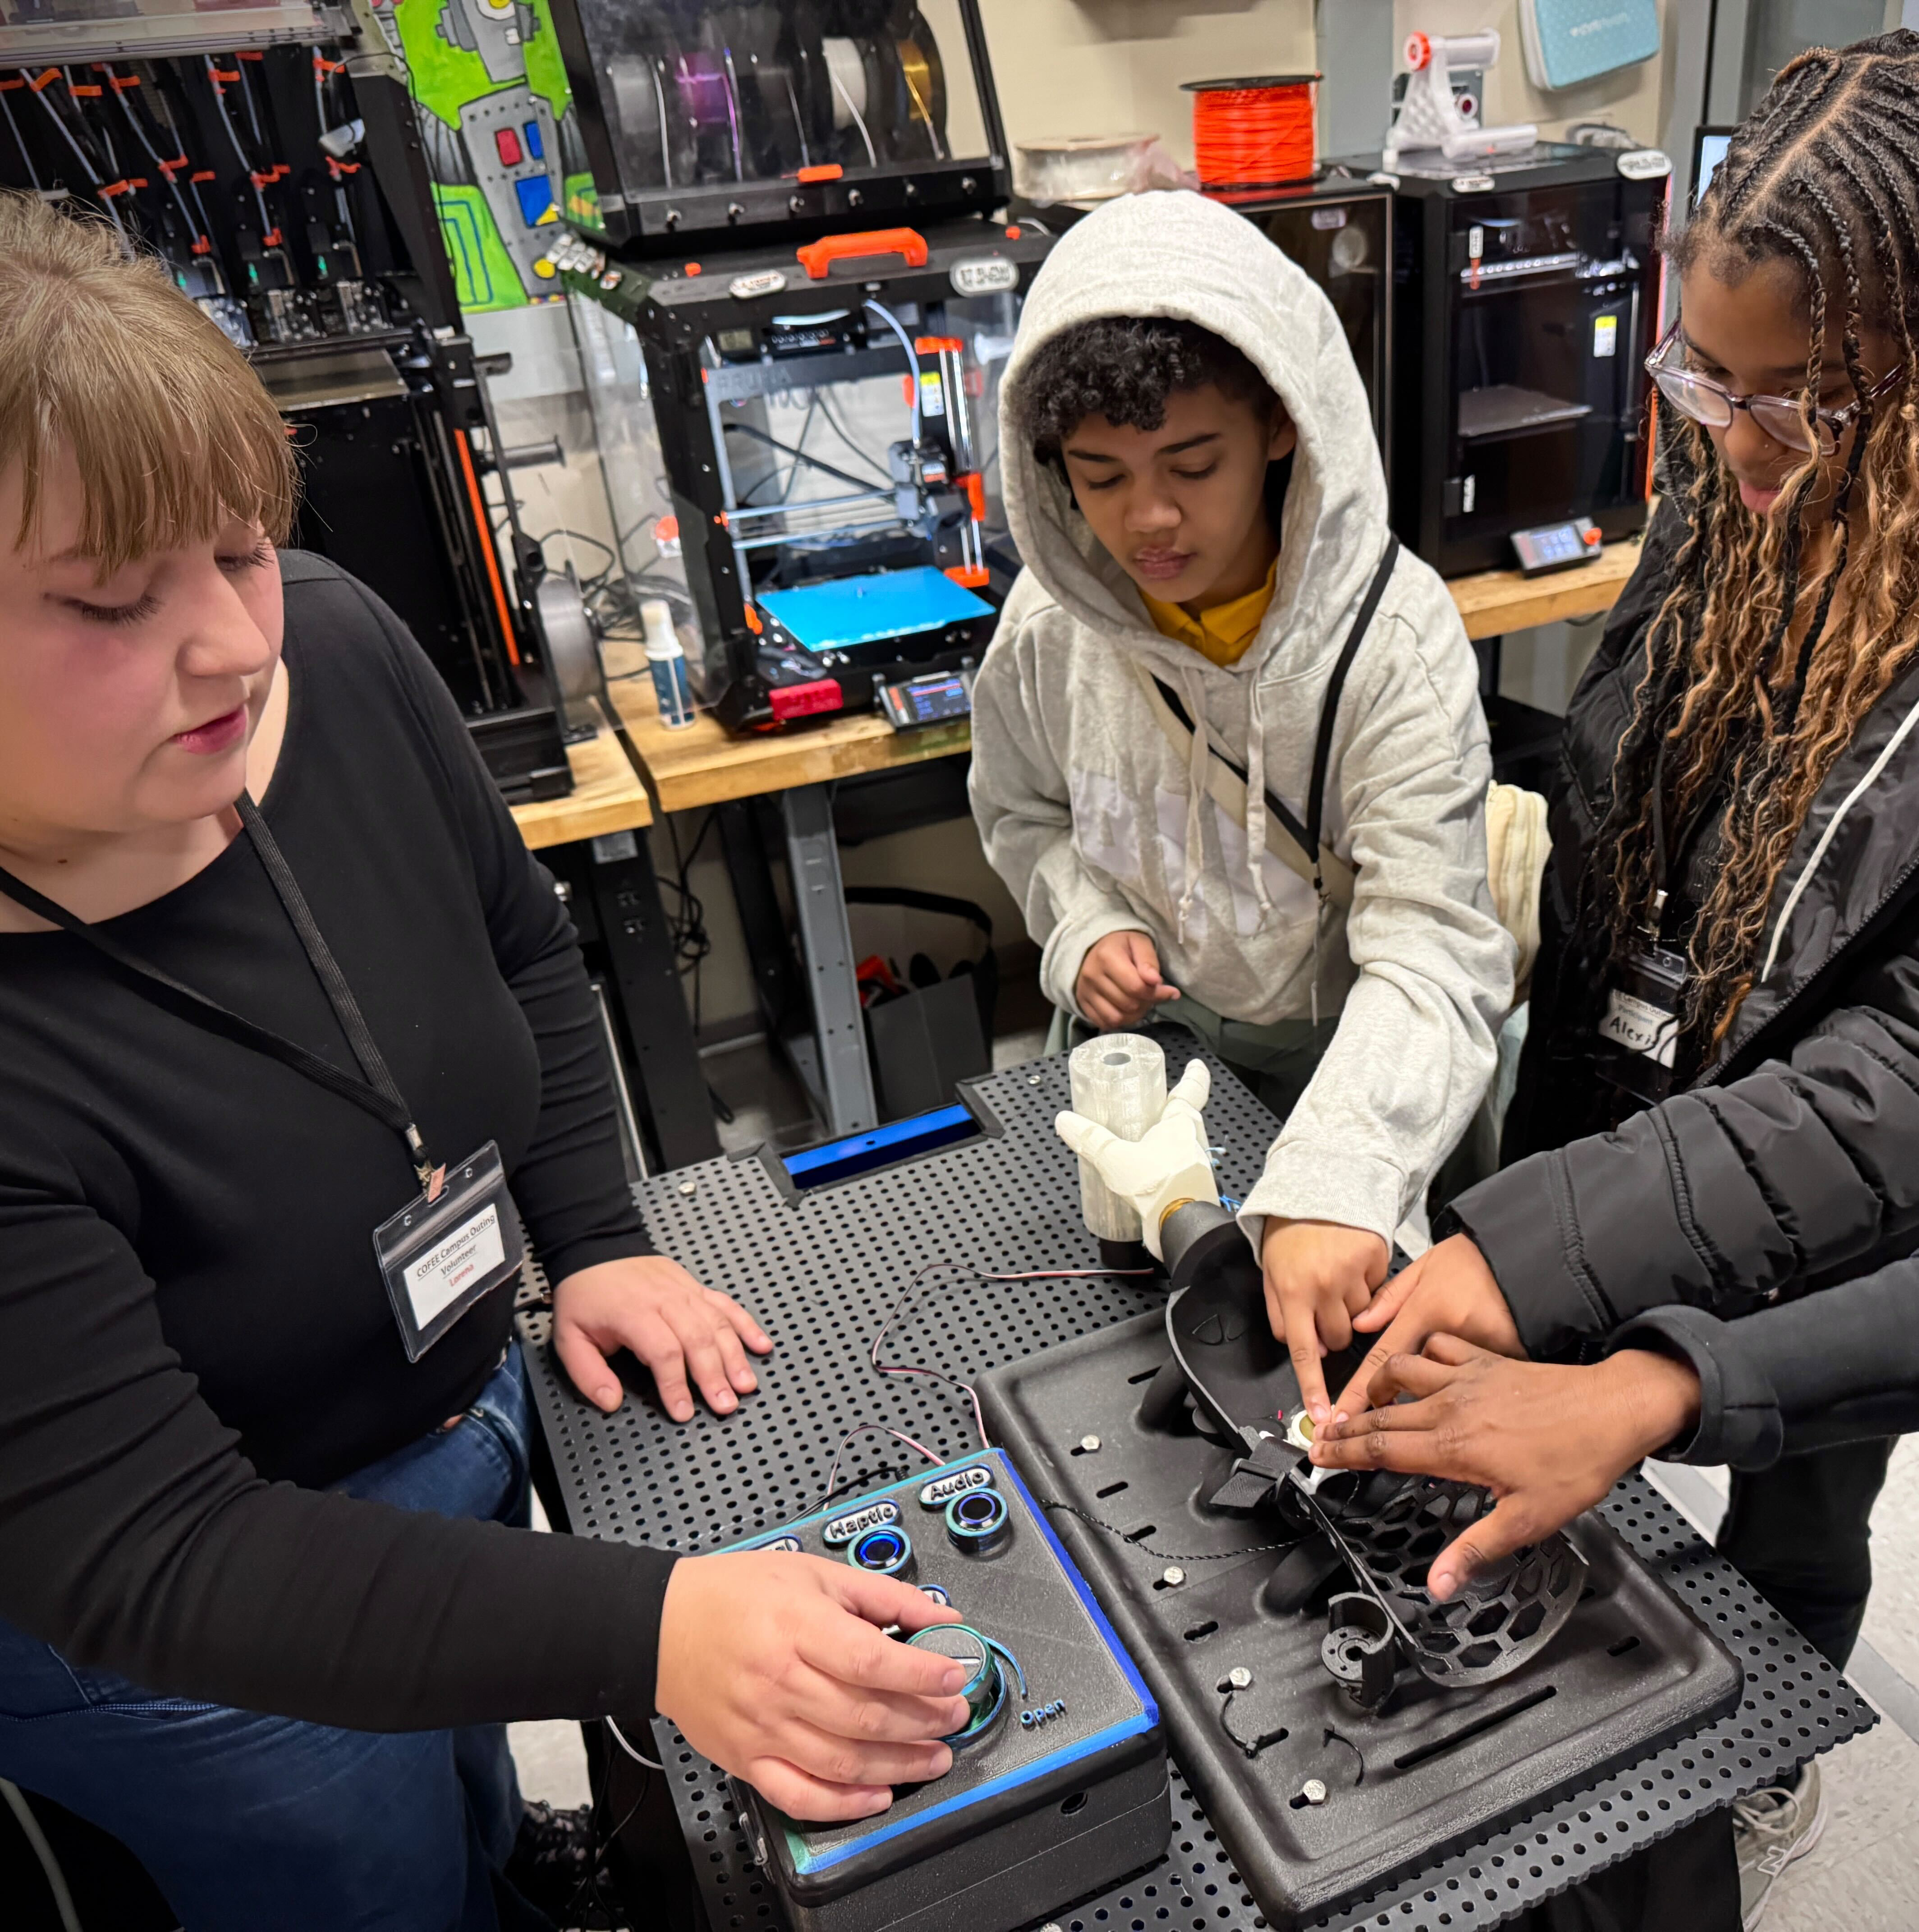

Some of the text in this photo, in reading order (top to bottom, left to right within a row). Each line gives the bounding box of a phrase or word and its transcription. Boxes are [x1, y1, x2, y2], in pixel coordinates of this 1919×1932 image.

[417, 1215, 495, 1278] COFEE Campus Outing
[441, 1244, 477, 1276] Volunteer
[449, 1264, 474, 1287] Lorena
[930, 1472, 984, 1500] Audio
[830, 1506, 893, 1539] Haptic
[1020, 1699, 1066, 1727] Open
